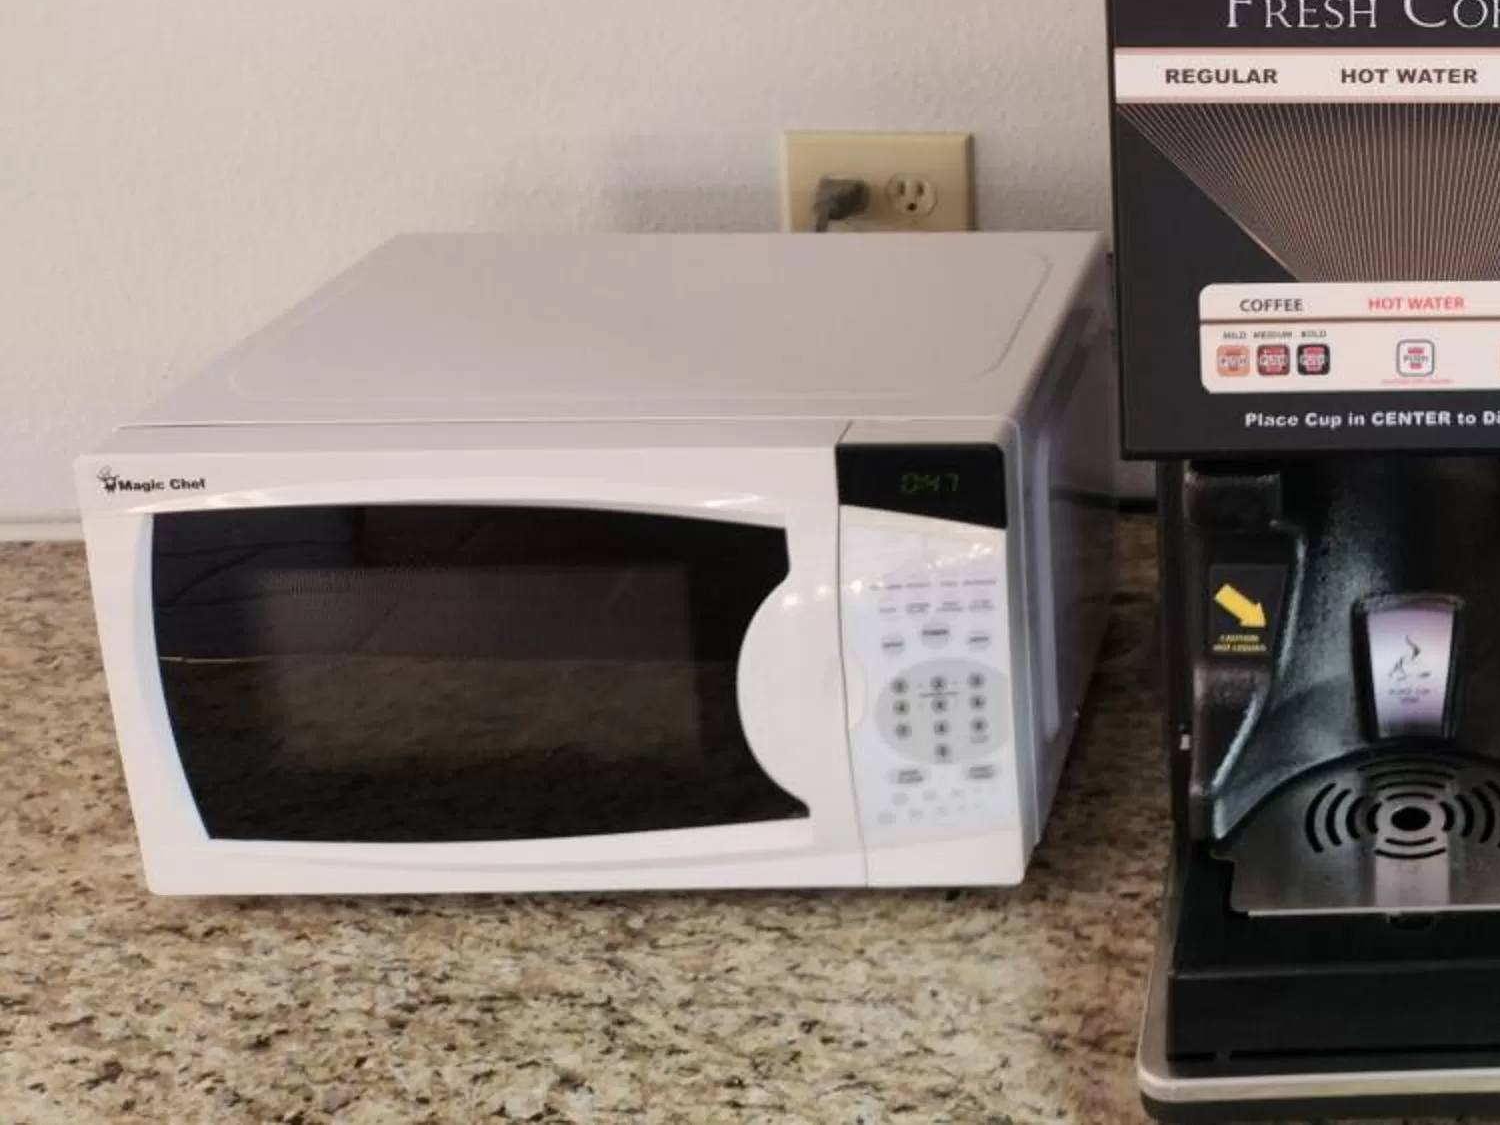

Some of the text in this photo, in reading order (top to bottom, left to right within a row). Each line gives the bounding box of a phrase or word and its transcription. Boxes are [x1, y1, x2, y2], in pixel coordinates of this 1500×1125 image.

[1164, 68, 1278, 85] REGULAR
[1340, 68, 1478, 85] HOT WATER
[1239, 297, 1304, 313] COFFEE
[1367, 296, 1465, 311] HOT WATER
[1244, 411, 1298, 427] Place
[1305, 411, 1342, 430] Cup
[1348, 411, 1365, 426] in
[1371, 410, 1451, 426] CENTER
[1457, 411, 1477, 425] to
[118, 477, 205, 493] Magic Chef
